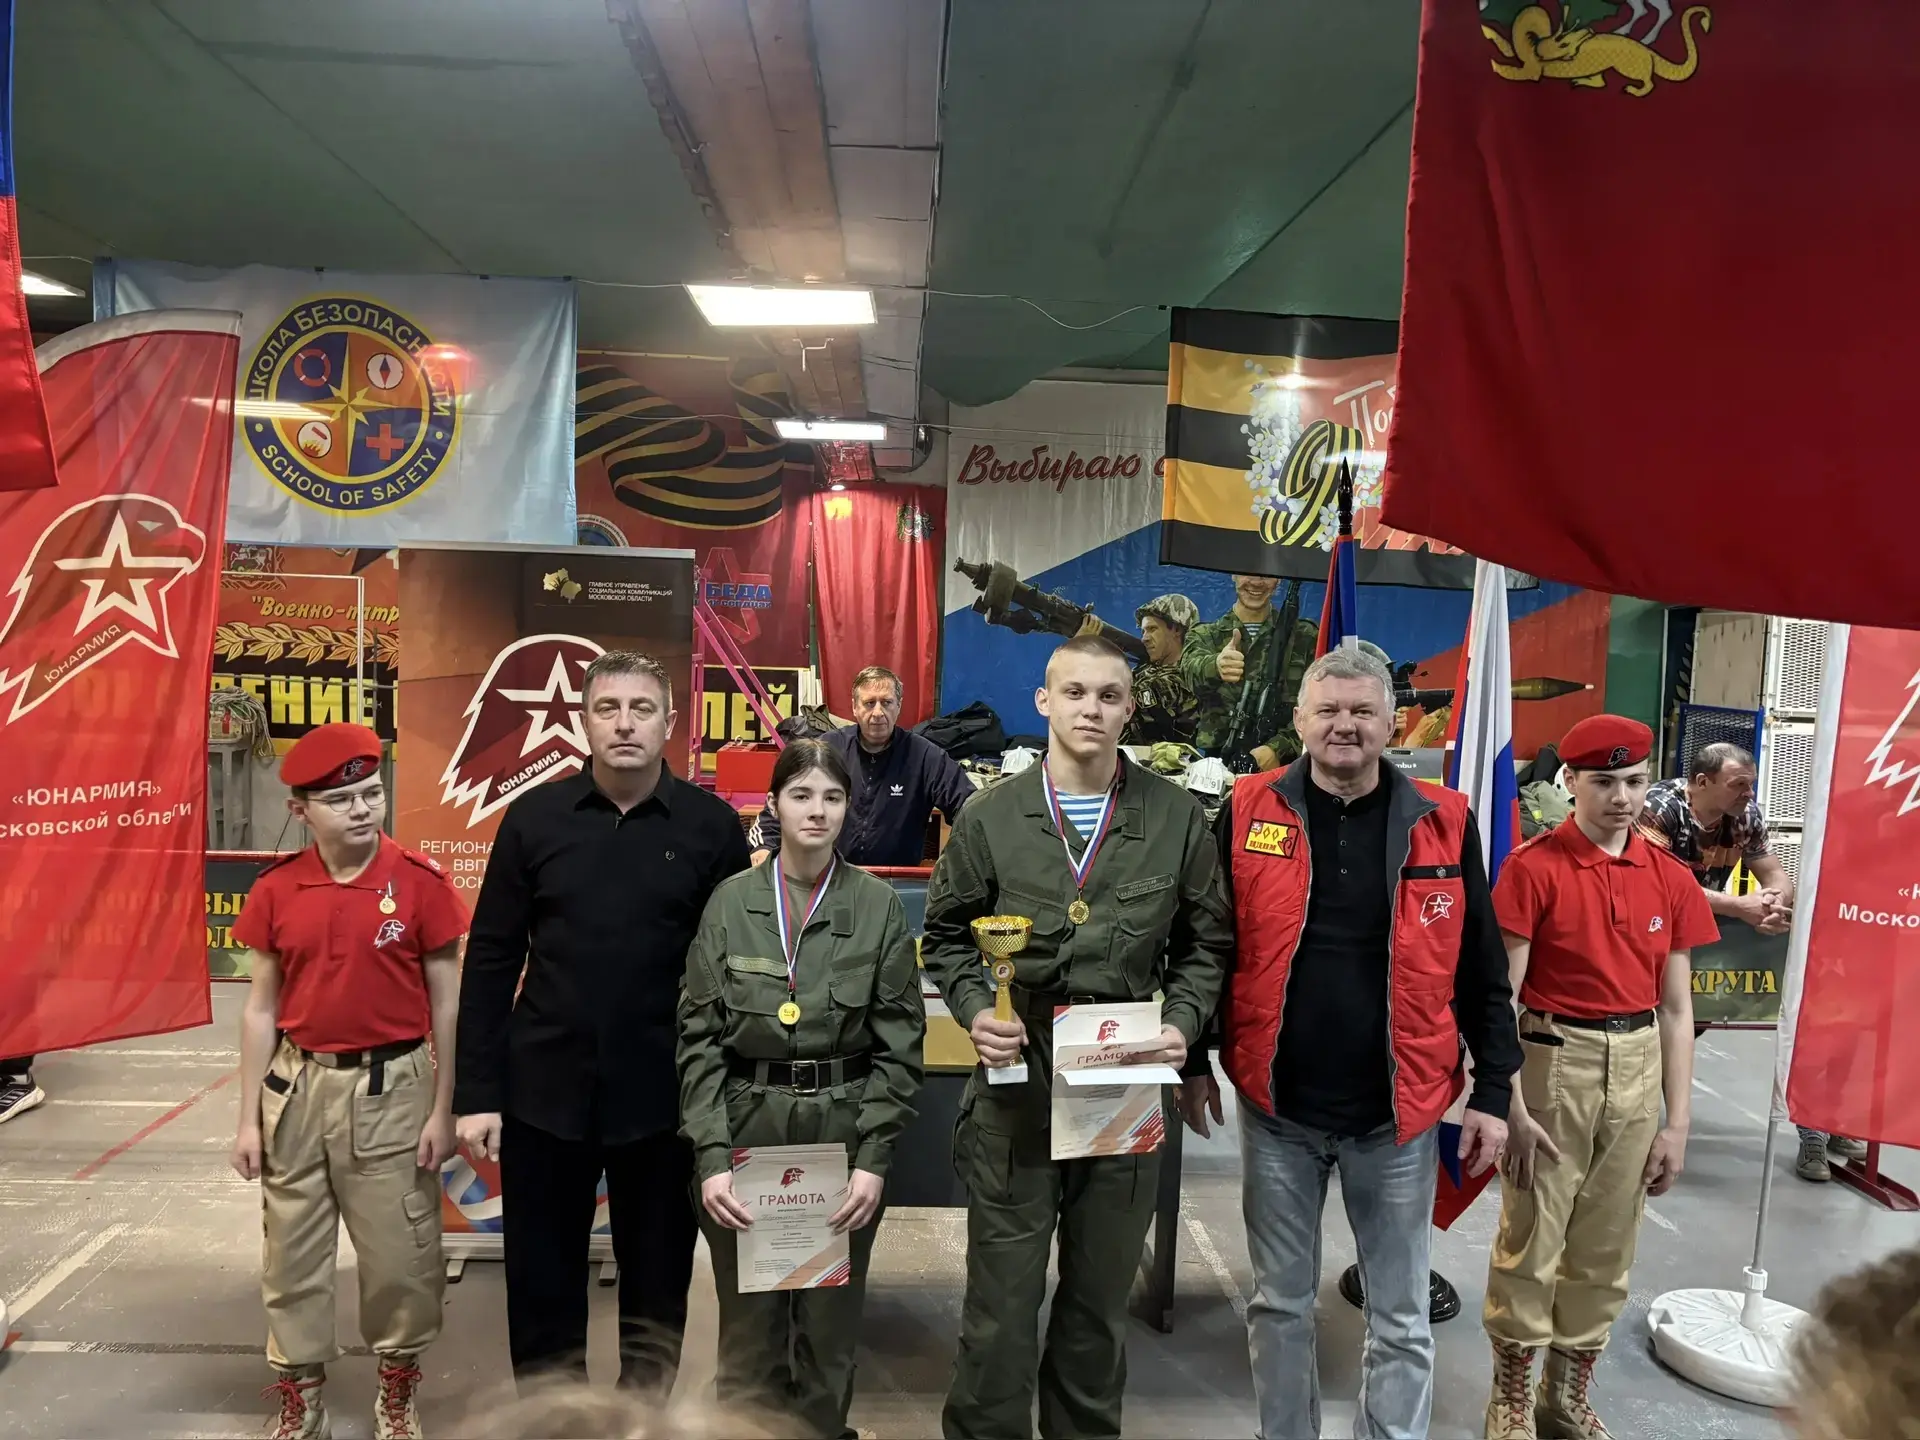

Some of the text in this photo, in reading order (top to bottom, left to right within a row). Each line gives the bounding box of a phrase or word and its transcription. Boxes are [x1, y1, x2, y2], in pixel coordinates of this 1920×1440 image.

[250, 303, 452, 417] ШКОЛА БЕЗОПАСНСТИ
[1333, 379, 1397, 449] По
[261, 444, 437, 505] SCHOOL OF SAFETY
[957, 444, 1141, 494] Выбираю
[588, 587, 627, 595] СОЦИАЛЬНЫХ
[614, 582, 650, 590] УПРАВЛЕНИЕ
[44, 624, 121, 683] ЮНАРМИЯ
[12, 780, 162, 806] «ЮНАРМИЯ»
[497, 750, 562, 794] ЮНАРМИЯ
[1838, 902, 1920, 928] Моско
[759, 1193, 826, 1206] ГРАМОТА
